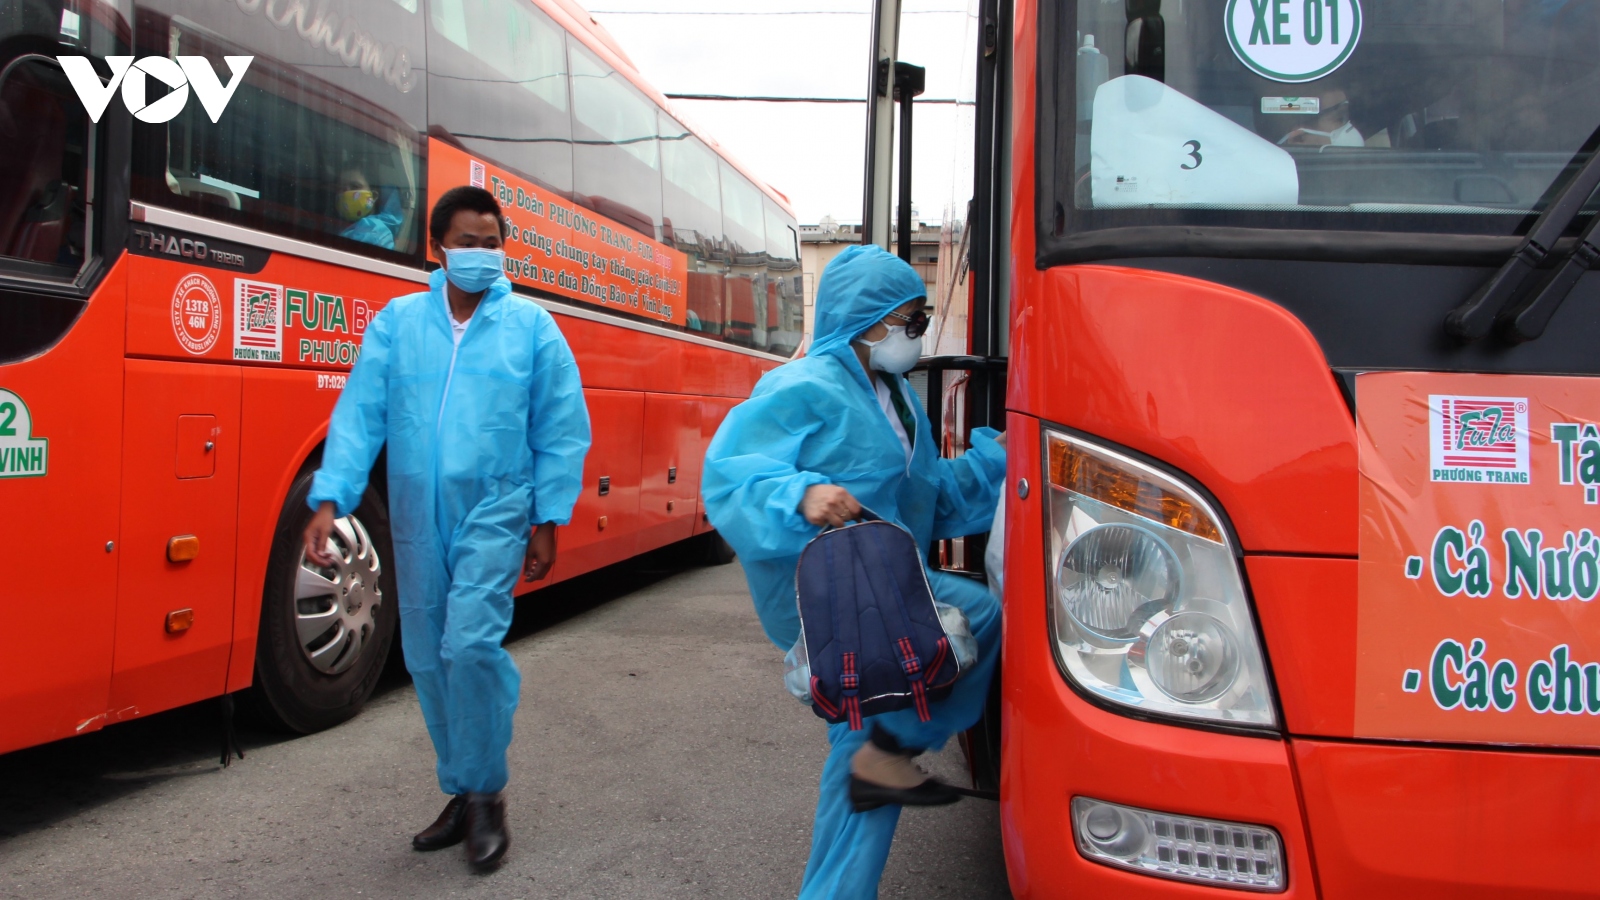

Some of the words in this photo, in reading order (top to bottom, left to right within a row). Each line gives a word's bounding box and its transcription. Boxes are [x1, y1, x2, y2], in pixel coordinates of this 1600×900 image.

[1248, 0, 1291, 45] XE
[1303, 0, 1339, 46] 01
[1180, 139, 1203, 170] 3
[491, 174, 514, 208] Tập
[516, 186, 544, 217] Đoàn
[549, 202, 597, 238] PHƯƠNG
[600, 225, 633, 254] TRANG
[638, 241, 654, 263] FUTA
[134, 228, 207, 259] THACO
[522, 226, 552, 257] cùng
[555, 239, 589, 269] chung
[591, 252, 608, 275] tay
[541, 266, 555, 284] xe
[557, 269, 577, 291] đưa
[185, 298, 209, 313] 13T8
[285, 287, 349, 334] FUTA
[188, 315, 206, 329] 46N
[260, 349, 281, 361] TRANG
[1432, 468, 1482, 482] PHƯƠNG
[1486, 470, 1528, 483] TRANG
[1431, 519, 1491, 598] Cả
[1429, 638, 1517, 711] Các
